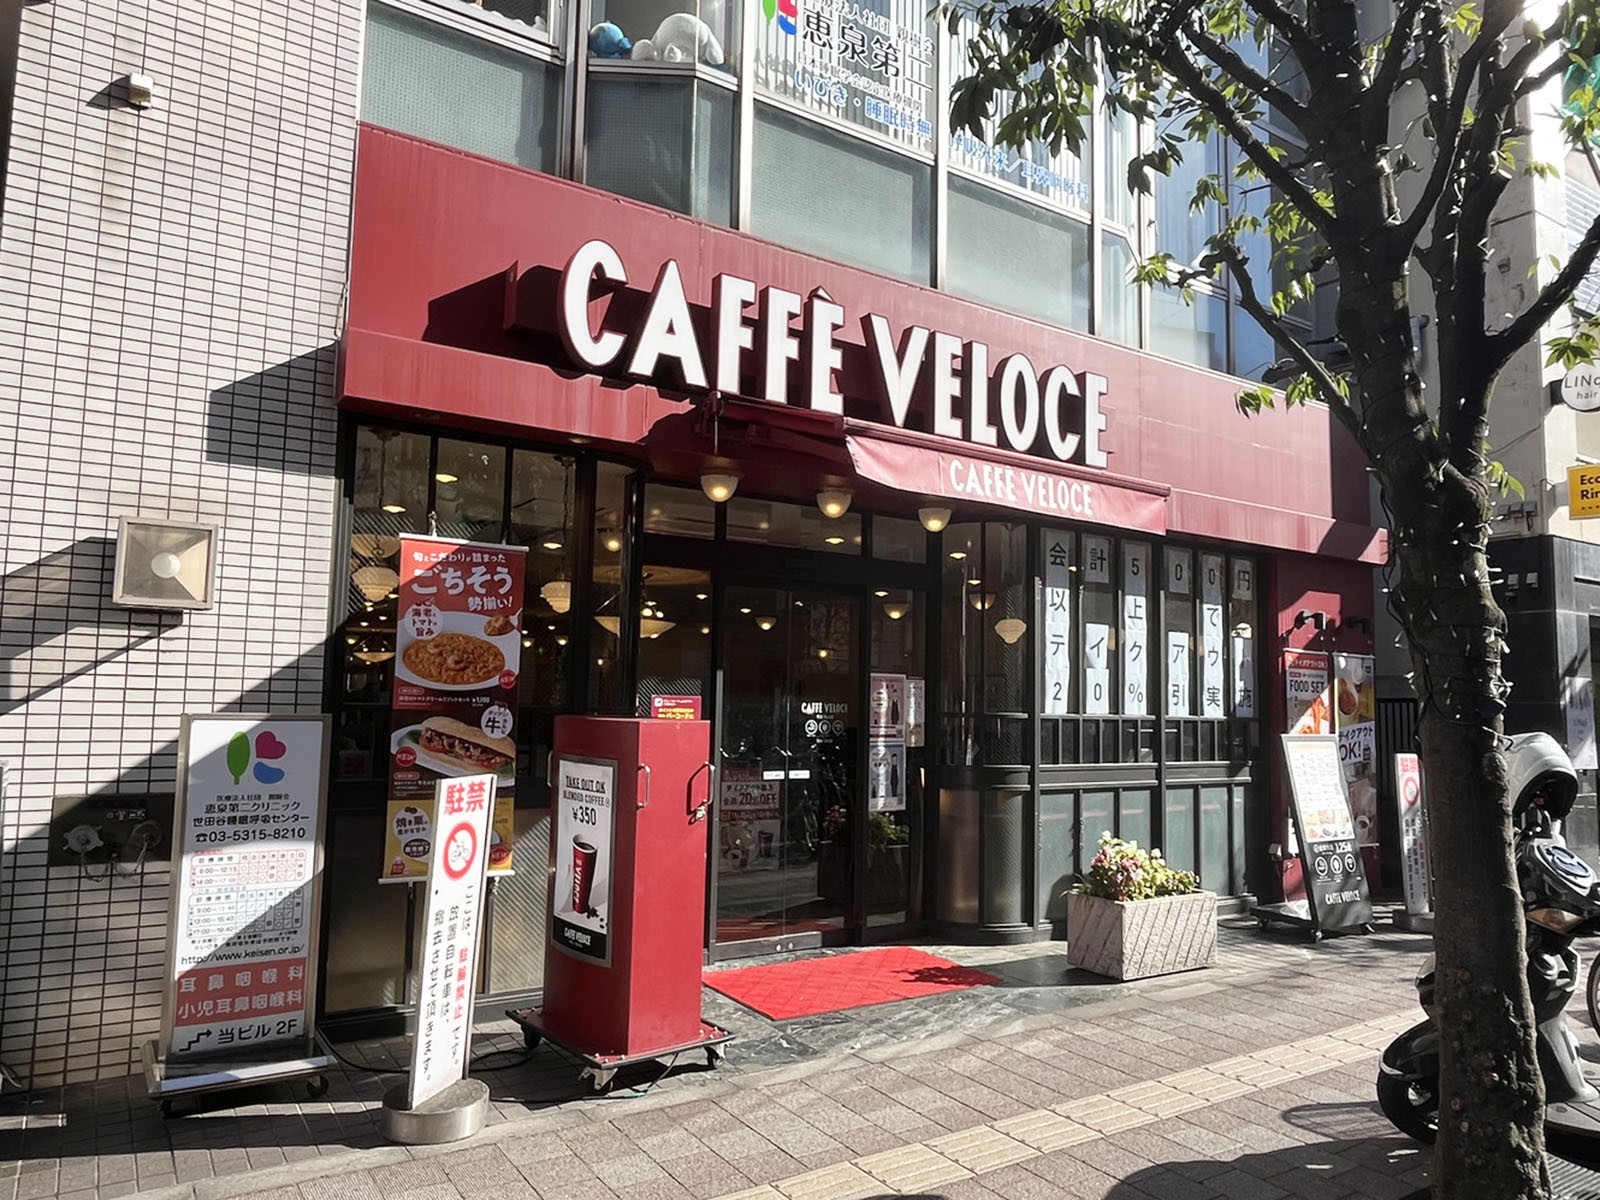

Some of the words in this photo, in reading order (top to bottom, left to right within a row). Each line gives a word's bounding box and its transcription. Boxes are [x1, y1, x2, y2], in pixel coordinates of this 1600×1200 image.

[870, 313, 1108, 468] VELOCE
[1021, 471, 1093, 516] VELOCE
[411, 565, 513, 596] ごちそう
[1289, 680, 1309, 693] FOOD
[485, 716, 501, 734] 牛
[1340, 741, 1361, 760] OK!
[444, 781, 486, 815] 駐禁
[208, 827, 306, 843] 03-5315-8210
[181, 943, 306, 965] http://www.keisen.or.jp/
[179, 965, 304, 993] 耳鼻咽喉科
[177, 989, 303, 1019] 小児耳鼻咽喉科
[217, 1023, 271, 1045] 当ビル
[276, 1018, 298, 1035] 2F
